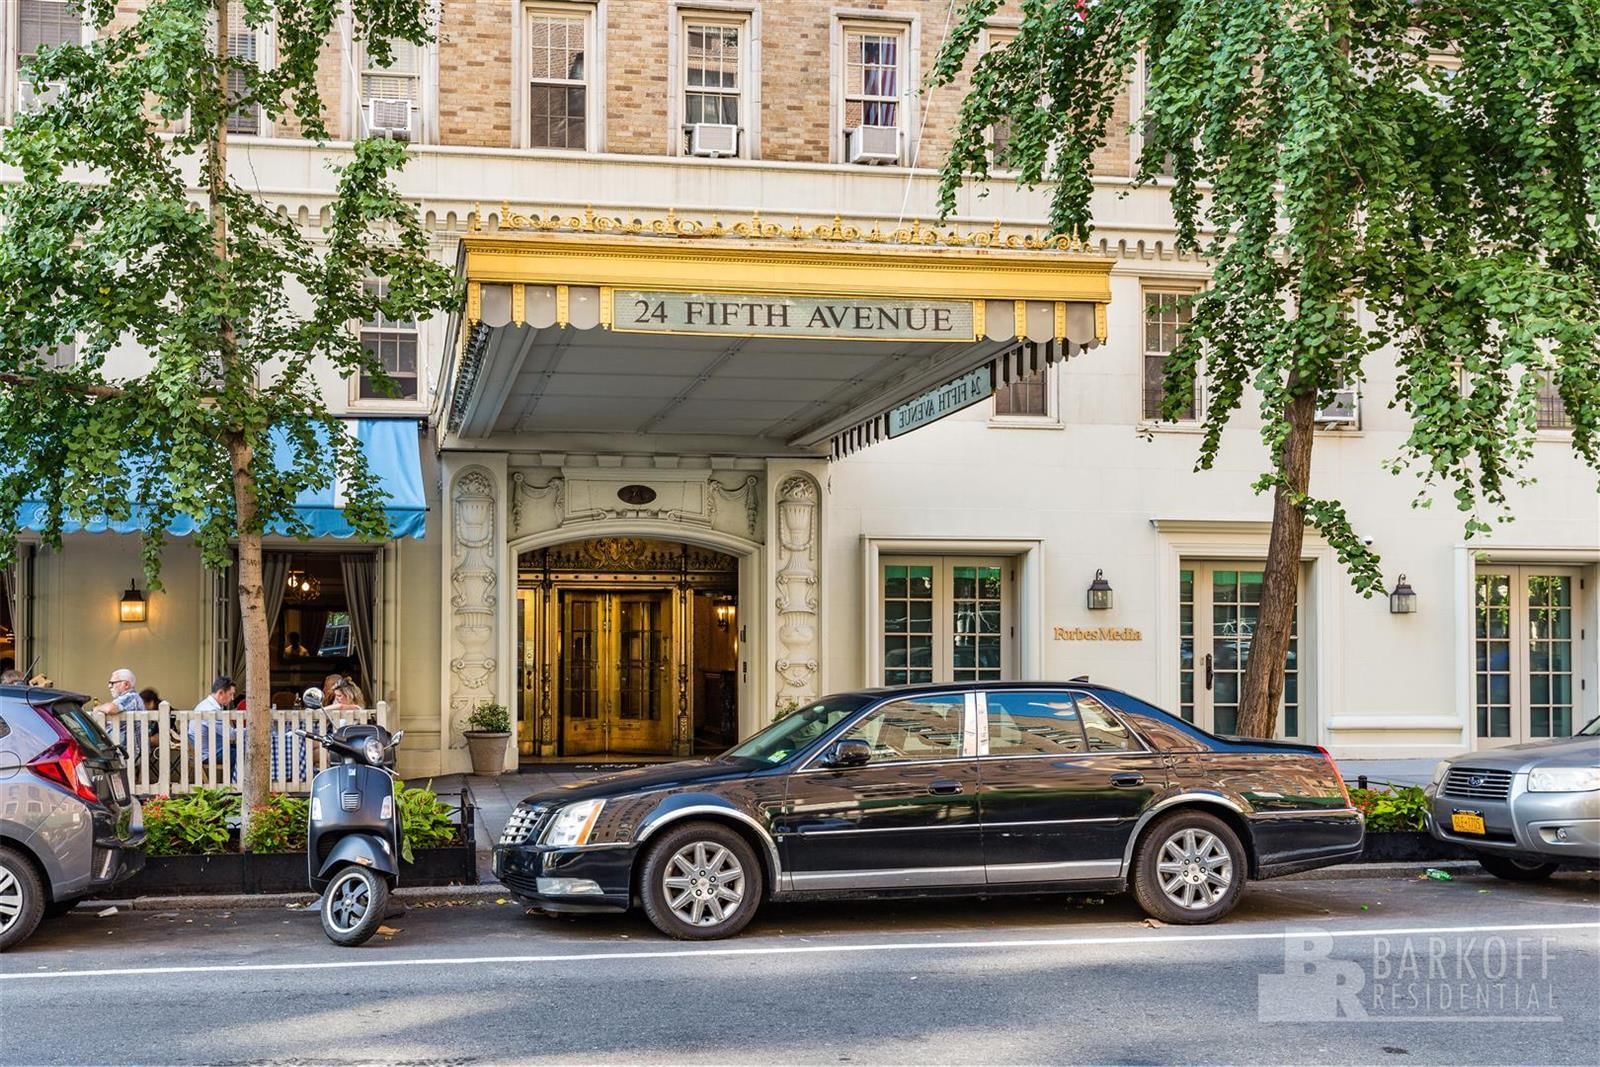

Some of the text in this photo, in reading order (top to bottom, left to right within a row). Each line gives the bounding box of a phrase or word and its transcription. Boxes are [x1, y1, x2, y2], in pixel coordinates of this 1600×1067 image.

[634, 300, 953, 332] 24 FIFTH AVENUE
